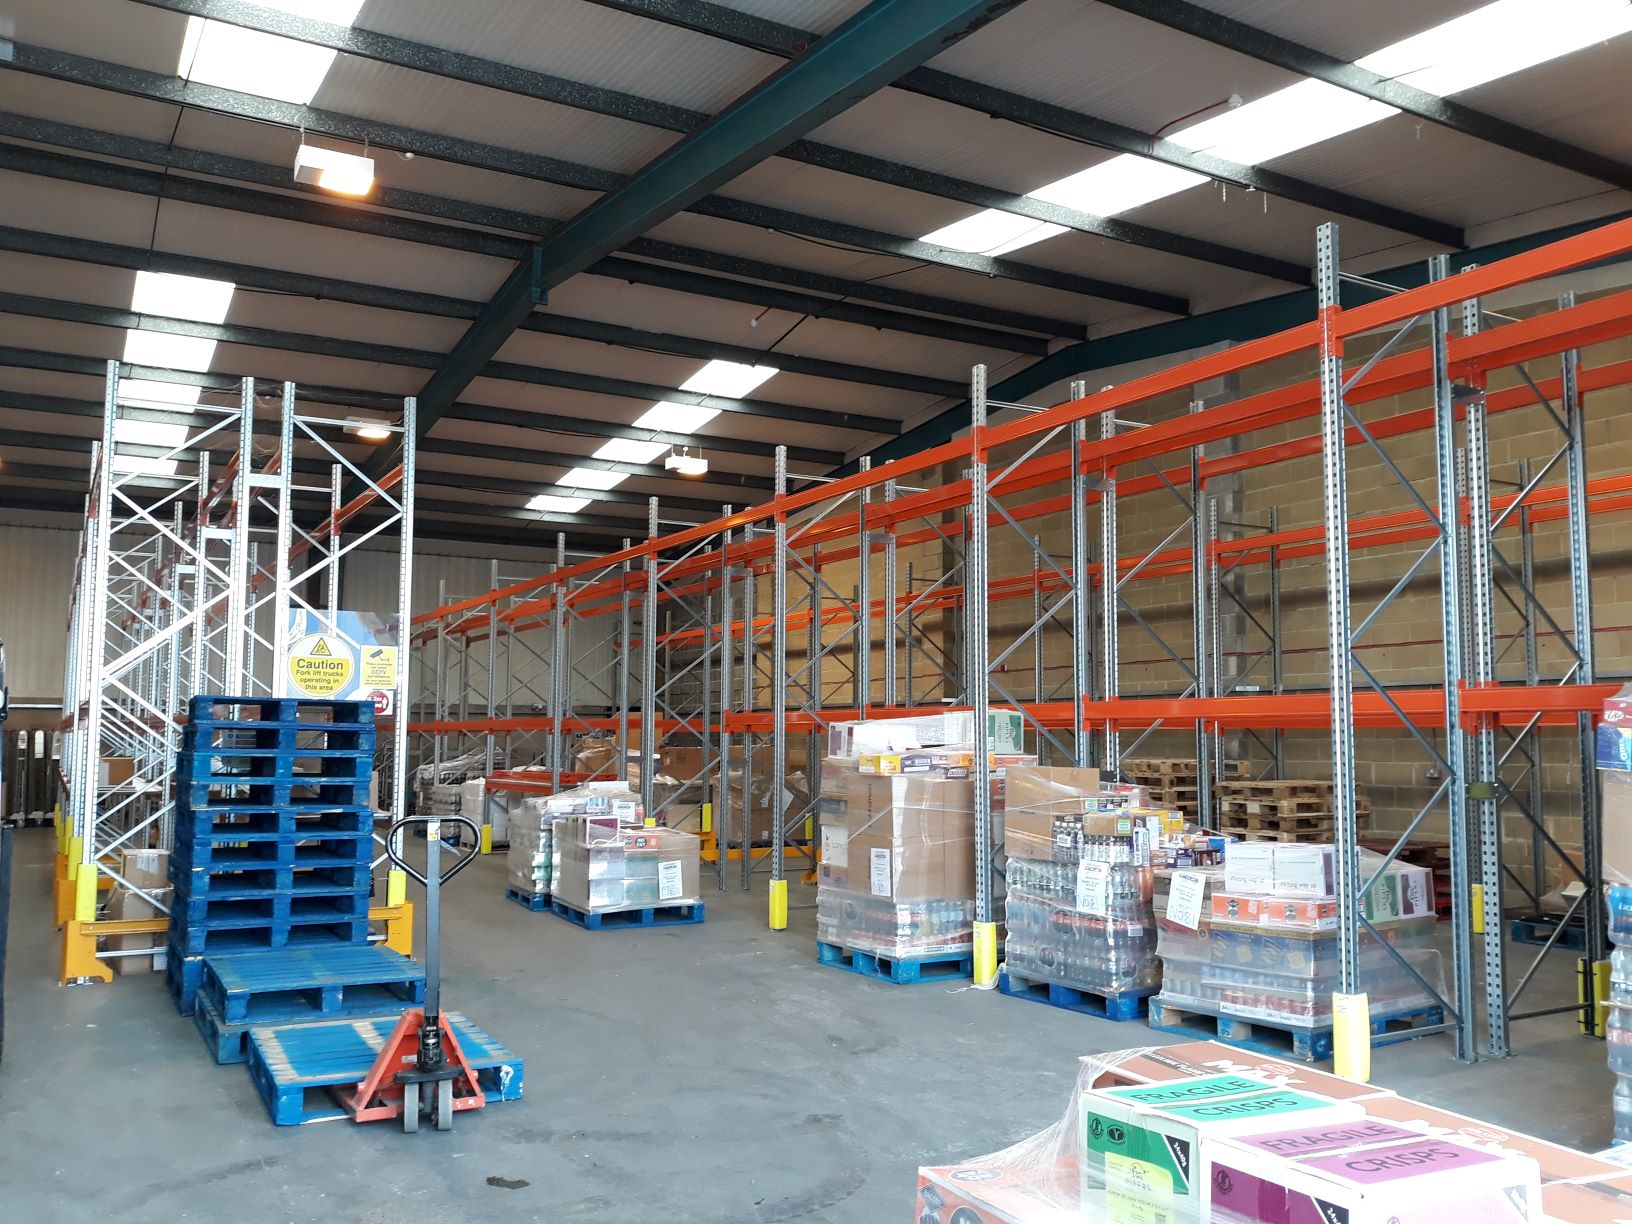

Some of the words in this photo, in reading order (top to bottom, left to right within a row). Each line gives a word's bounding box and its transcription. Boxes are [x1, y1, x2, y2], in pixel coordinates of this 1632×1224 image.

[297, 659, 344, 670] Caution
[300, 677, 332, 685] operating
[1131, 1080, 1255, 1104] FRAGILE
[1192, 1097, 1299, 1117] CRISPS
[1260, 1124, 1399, 1150] FRAGILE
[1345, 1148, 1461, 1172] CRISPS
[1327, 1207, 1341, 1224] 24x
